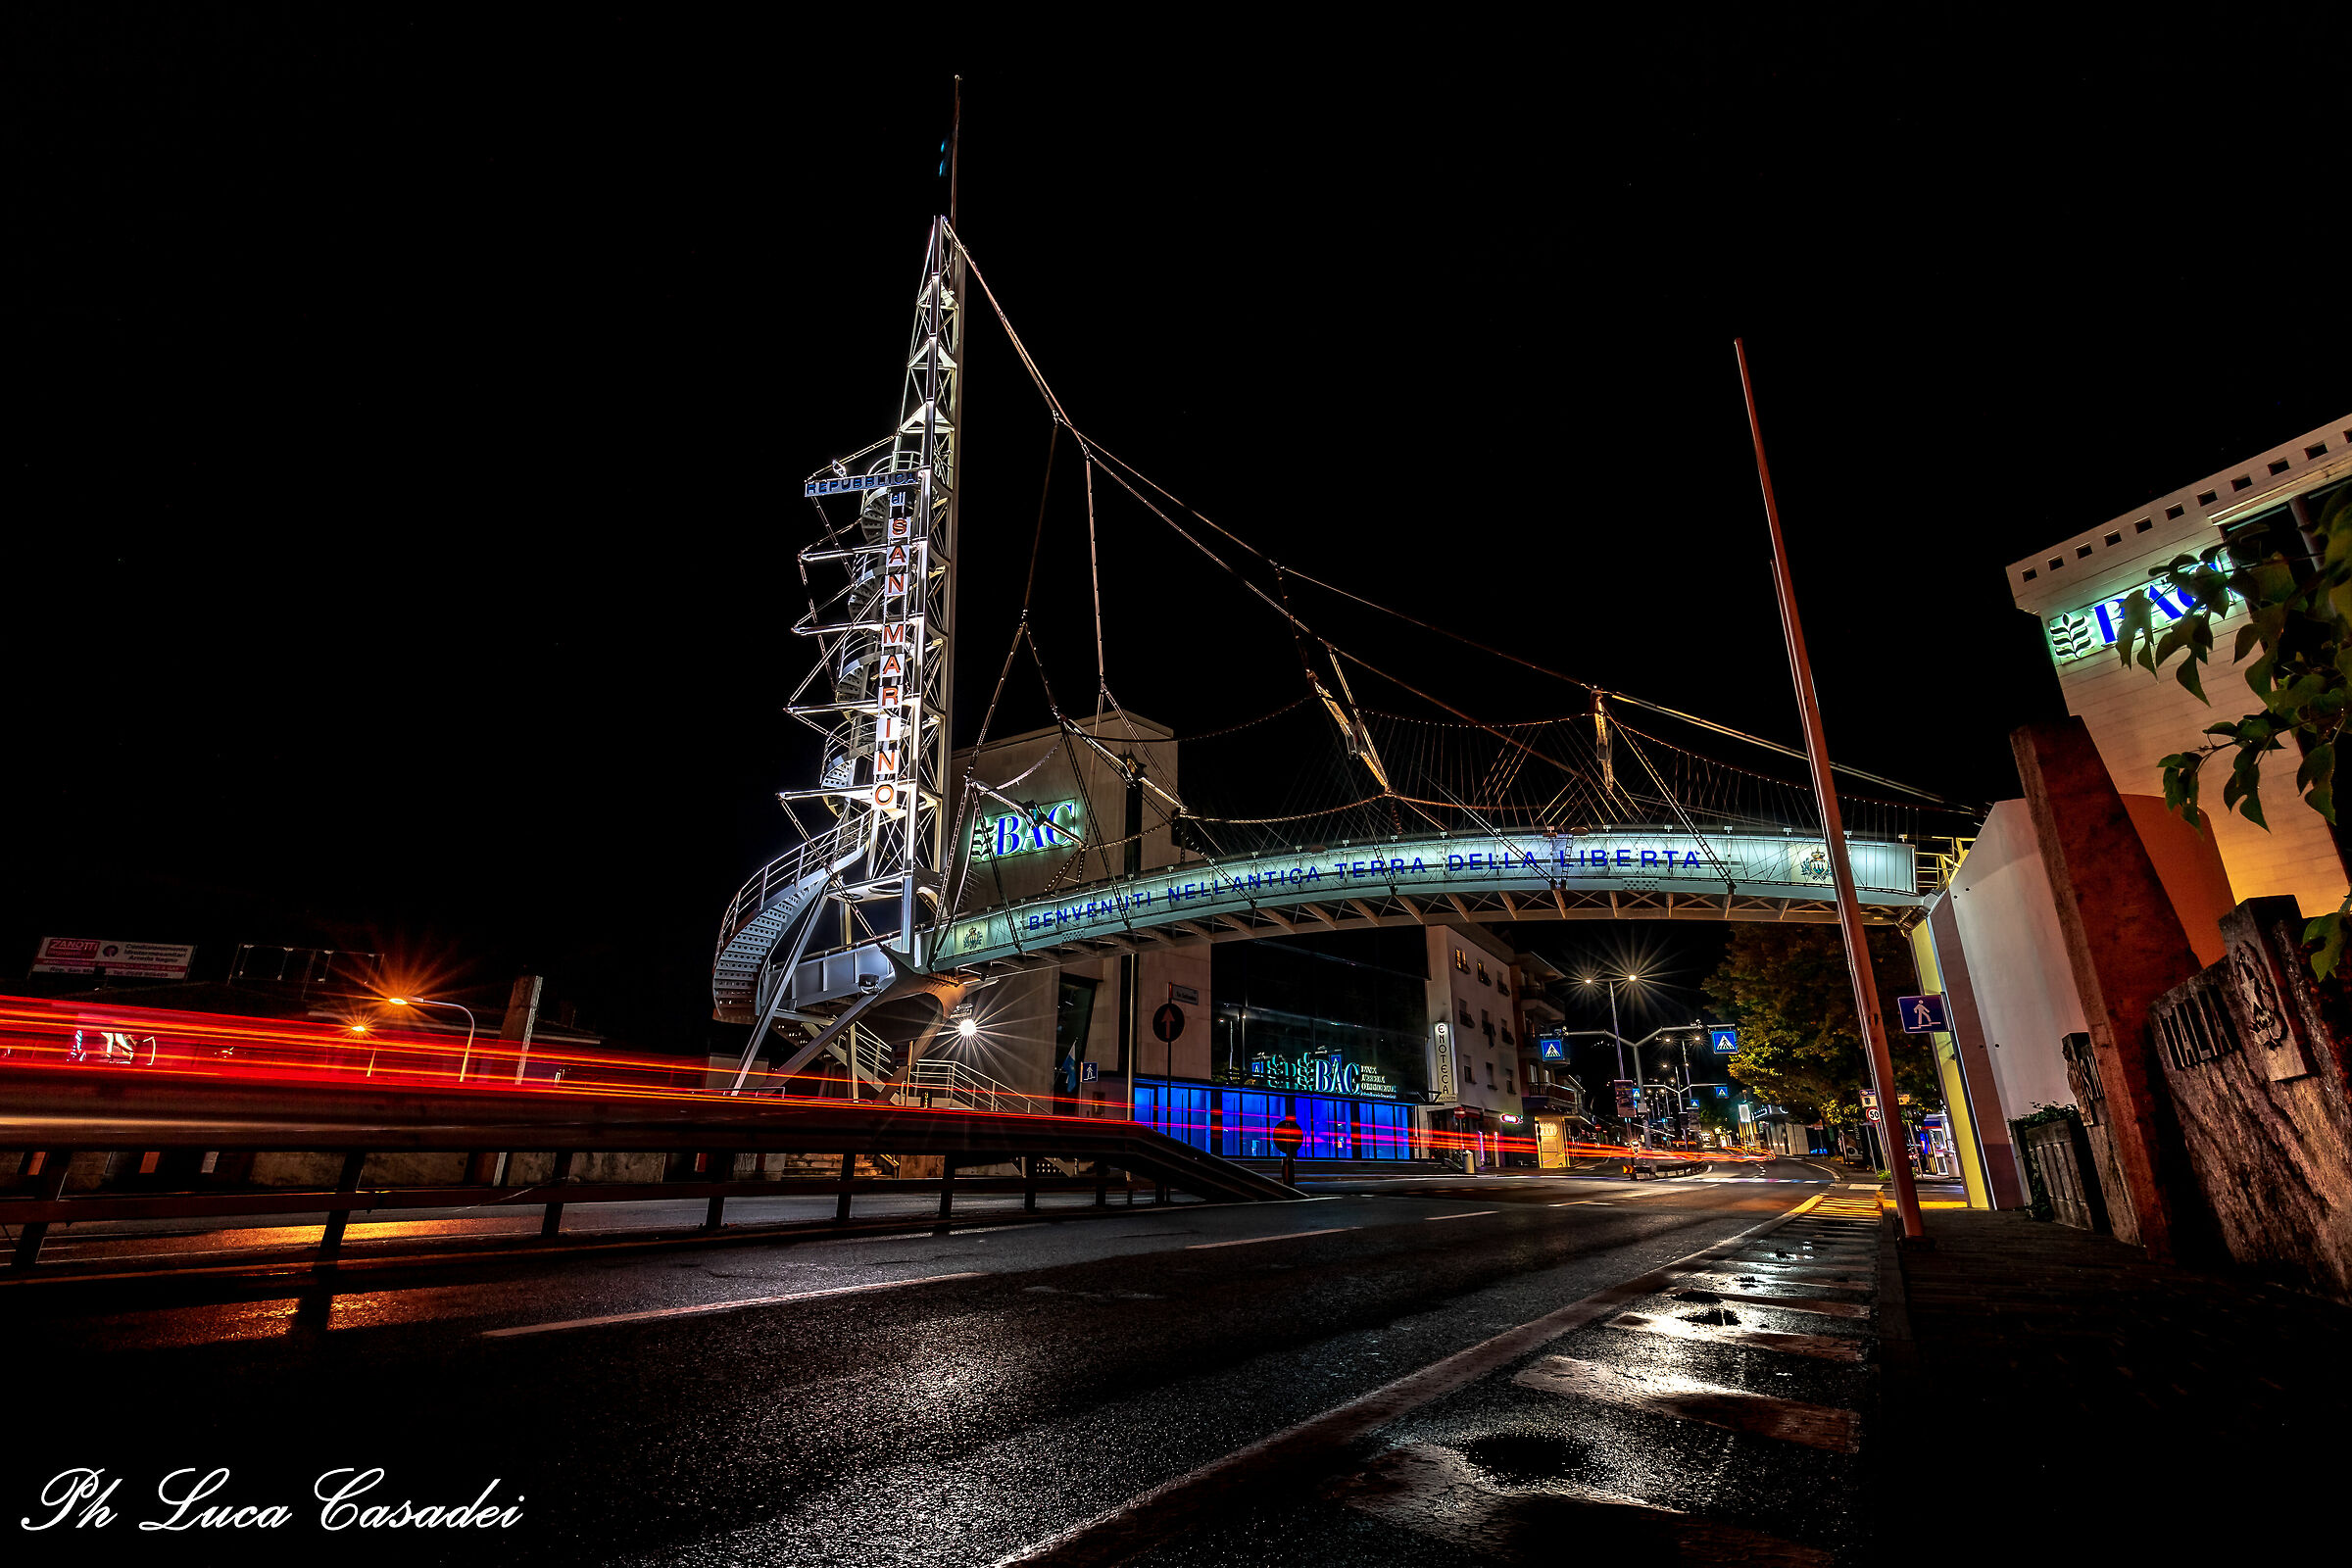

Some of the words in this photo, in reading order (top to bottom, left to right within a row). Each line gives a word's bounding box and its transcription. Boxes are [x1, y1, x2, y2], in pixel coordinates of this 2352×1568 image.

[807, 472, 917, 495] REPUBBLICA
[888, 518, 907, 594] SAN
[874, 623, 905, 807] MARINO
[996, 802, 1075, 857] BAC
[1029, 891, 1152, 931] BENVENUTI
[1334, 857, 1427, 880] TERRA
[1447, 851, 1539, 872] DELLA
[49, 940, 99, 951] ZANOTTI
[1315, 1058, 1360, 1096] BAC
[1438, 1024, 1449, 1095] ENOTECA
[1870, 1110, 1880, 1119] 50
